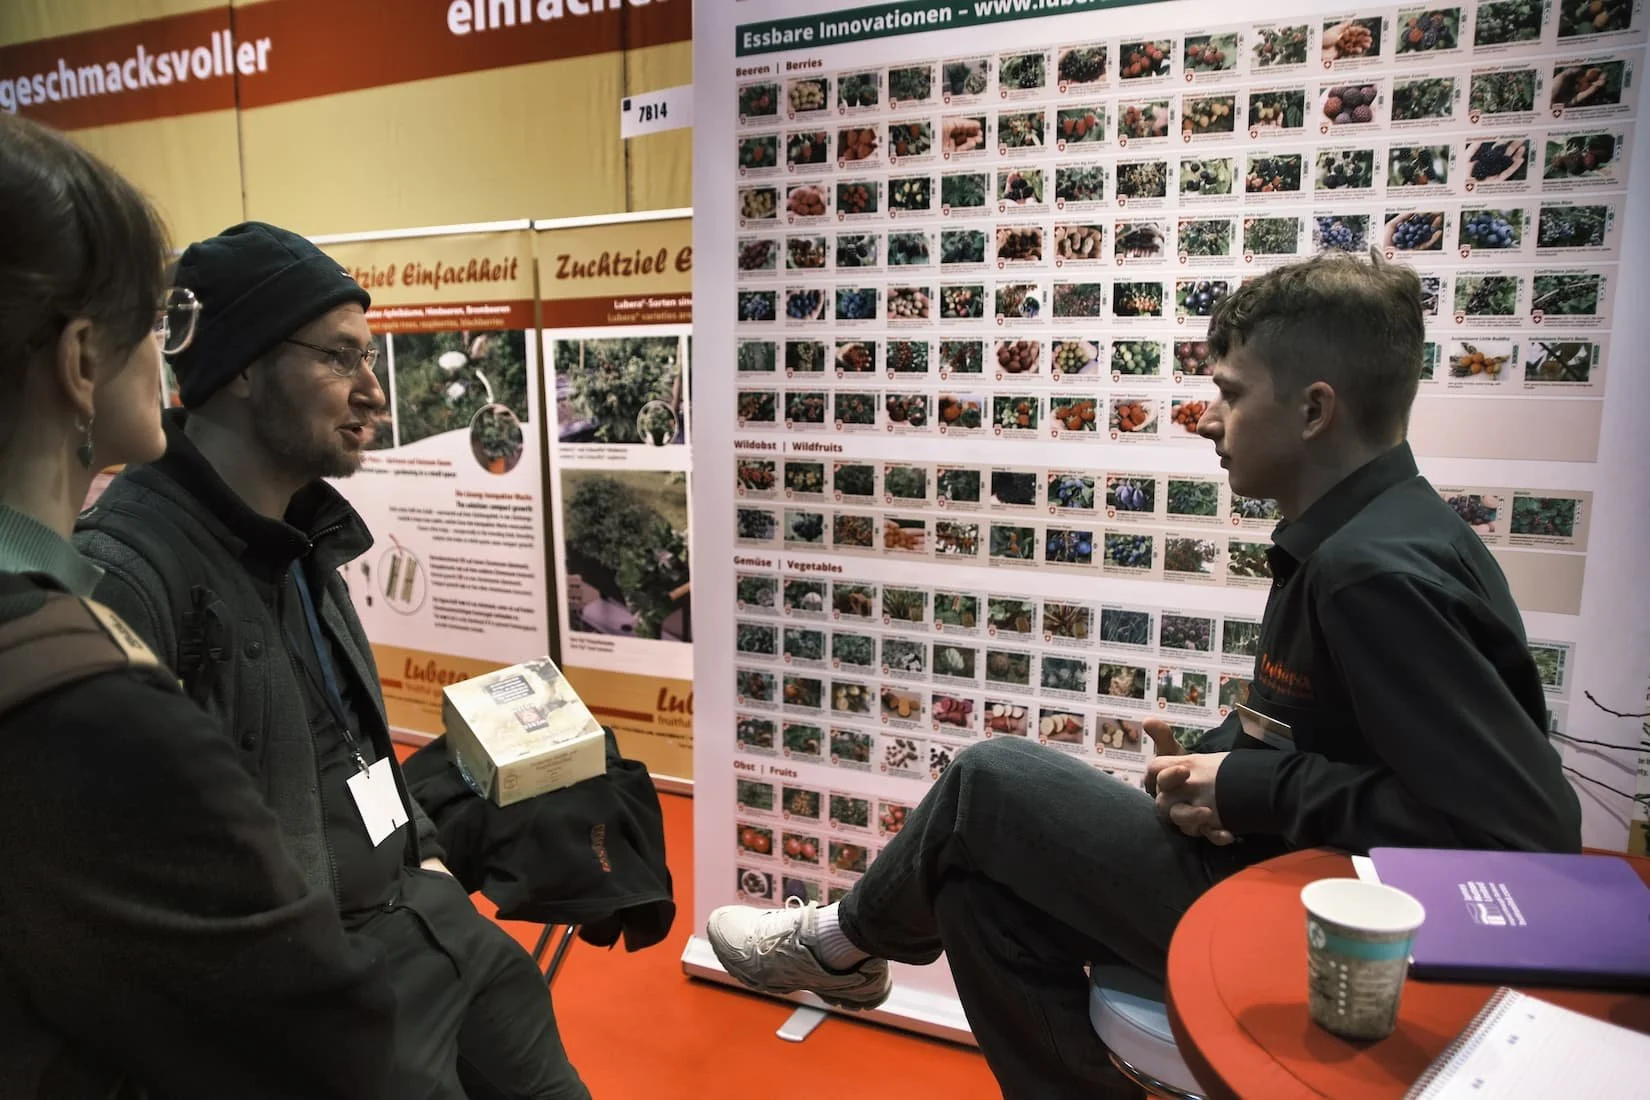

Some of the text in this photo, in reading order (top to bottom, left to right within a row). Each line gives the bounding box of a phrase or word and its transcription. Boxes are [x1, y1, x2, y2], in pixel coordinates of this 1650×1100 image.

[743, 27, 814, 48] Essbare
[820, 7, 952, 38] Innovationen
[0, 29, 271, 115] geschmacksvoller
[736, 65, 770, 77] Beeren
[786, 58, 823, 71] Berries
[639, 101, 668, 123] 7B14
[355, 256, 518, 291] tziel Einfachheit
[556, 246, 693, 279] Zuchtziel E
[734, 440, 776, 450] Wildobst
[792, 441, 843, 452] Wildfruits
[733, 556, 772, 567] Gemüse
[787, 560, 843, 573] Vegetables
[733, 760, 755, 771] Obst
[769, 765, 797, 778] Fruits
